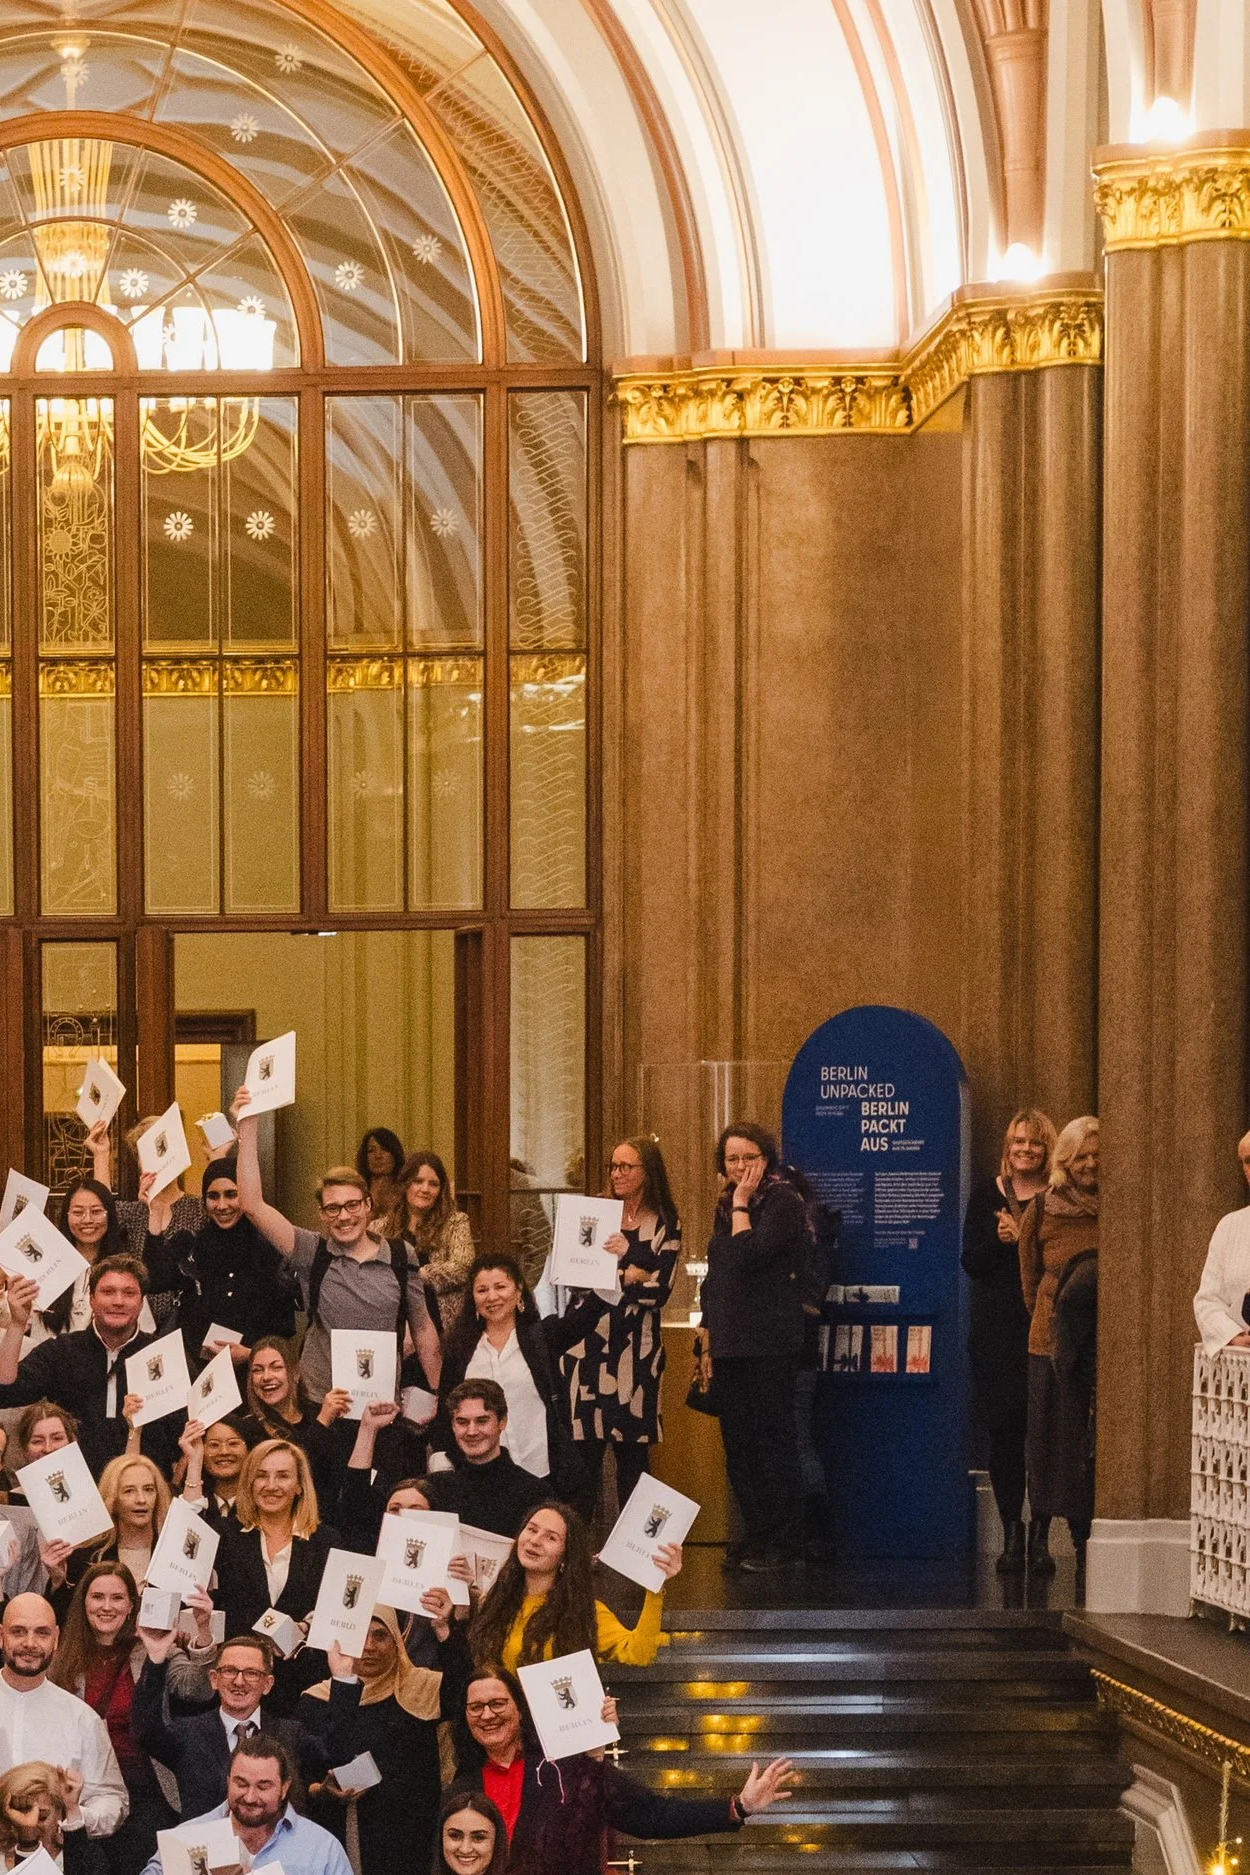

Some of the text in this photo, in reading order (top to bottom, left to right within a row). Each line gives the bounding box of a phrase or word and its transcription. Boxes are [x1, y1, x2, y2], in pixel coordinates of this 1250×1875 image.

[820, 1066, 868, 1080] BERLIN
[820, 1083, 895, 1099] UNPACKED
[861, 1101, 909, 1116] BERLIN
[860, 1119, 906, 1133] PACKT
[860, 1137, 888, 1151] AUS
[568, 1257, 598, 1266] BERLIN
[351, 1389, 379, 1399] BERLIN
[57, 1508, 88, 1525] BERLIN
